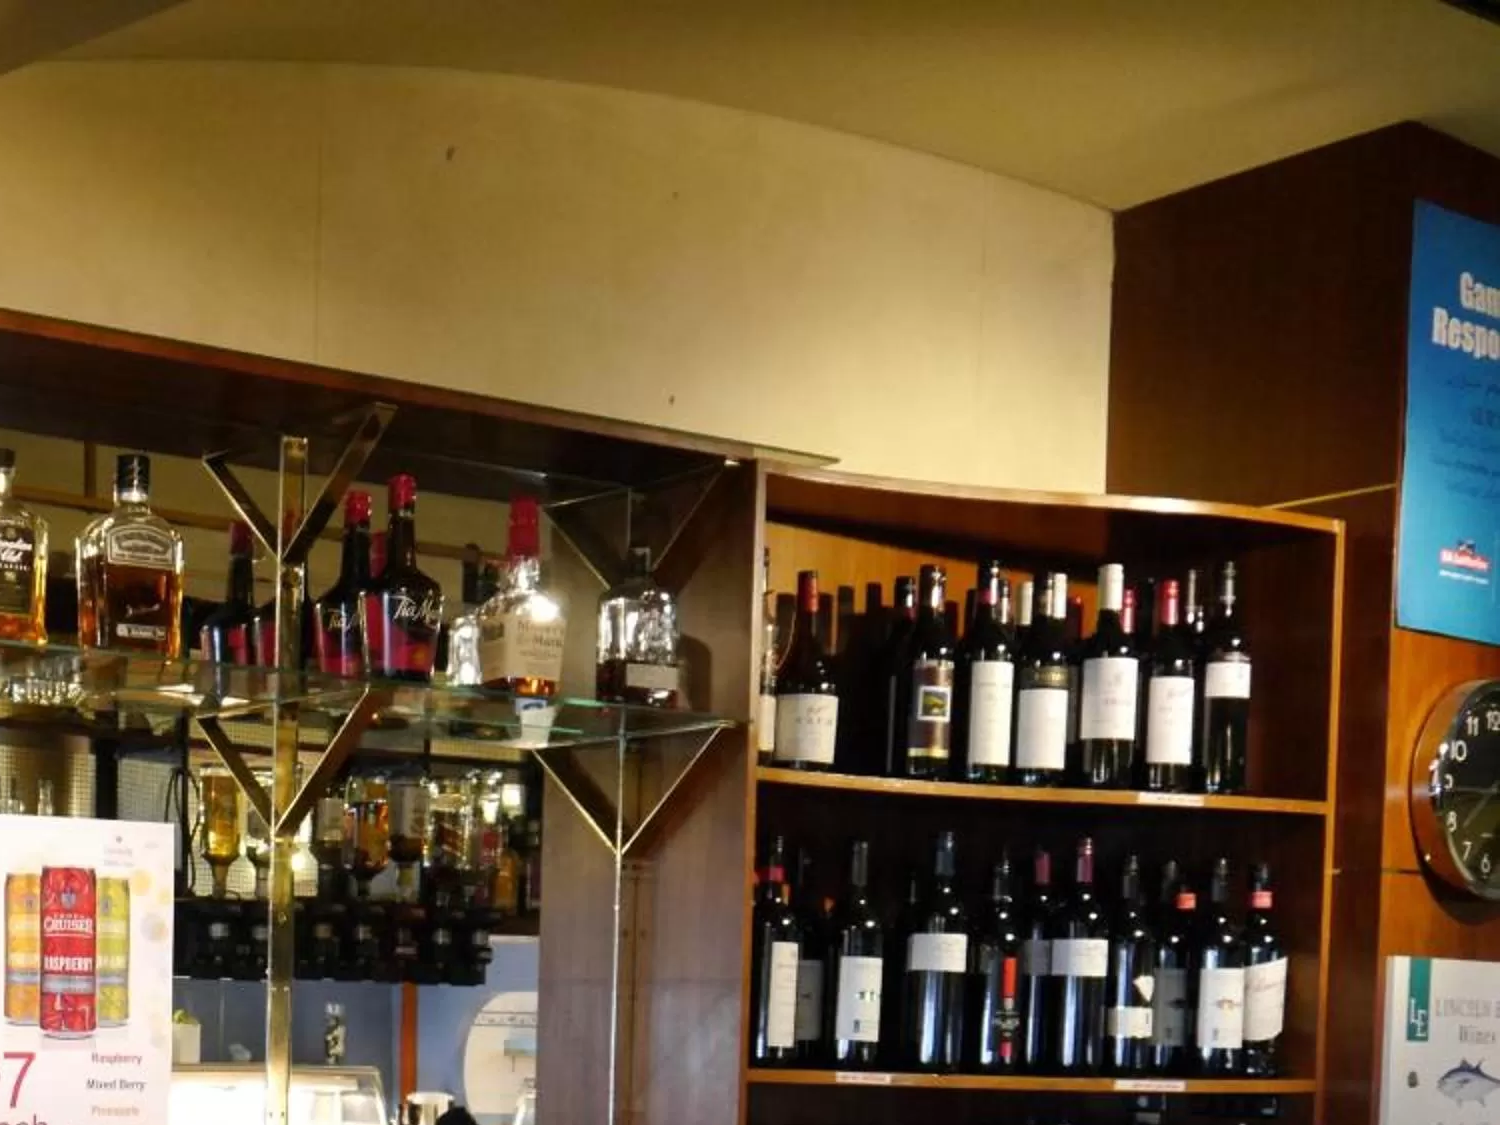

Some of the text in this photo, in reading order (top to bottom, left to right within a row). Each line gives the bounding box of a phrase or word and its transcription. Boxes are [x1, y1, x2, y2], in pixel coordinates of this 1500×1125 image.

[1466, 716, 1480, 736] 11
[1450, 739, 1467, 761] 10
[1446, 811, 1457, 832] 8
[1462, 841, 1473, 861] 7
[1480, 854, 1491, 874] 6
[86, 1079, 147, 1092] Mixed Berry
